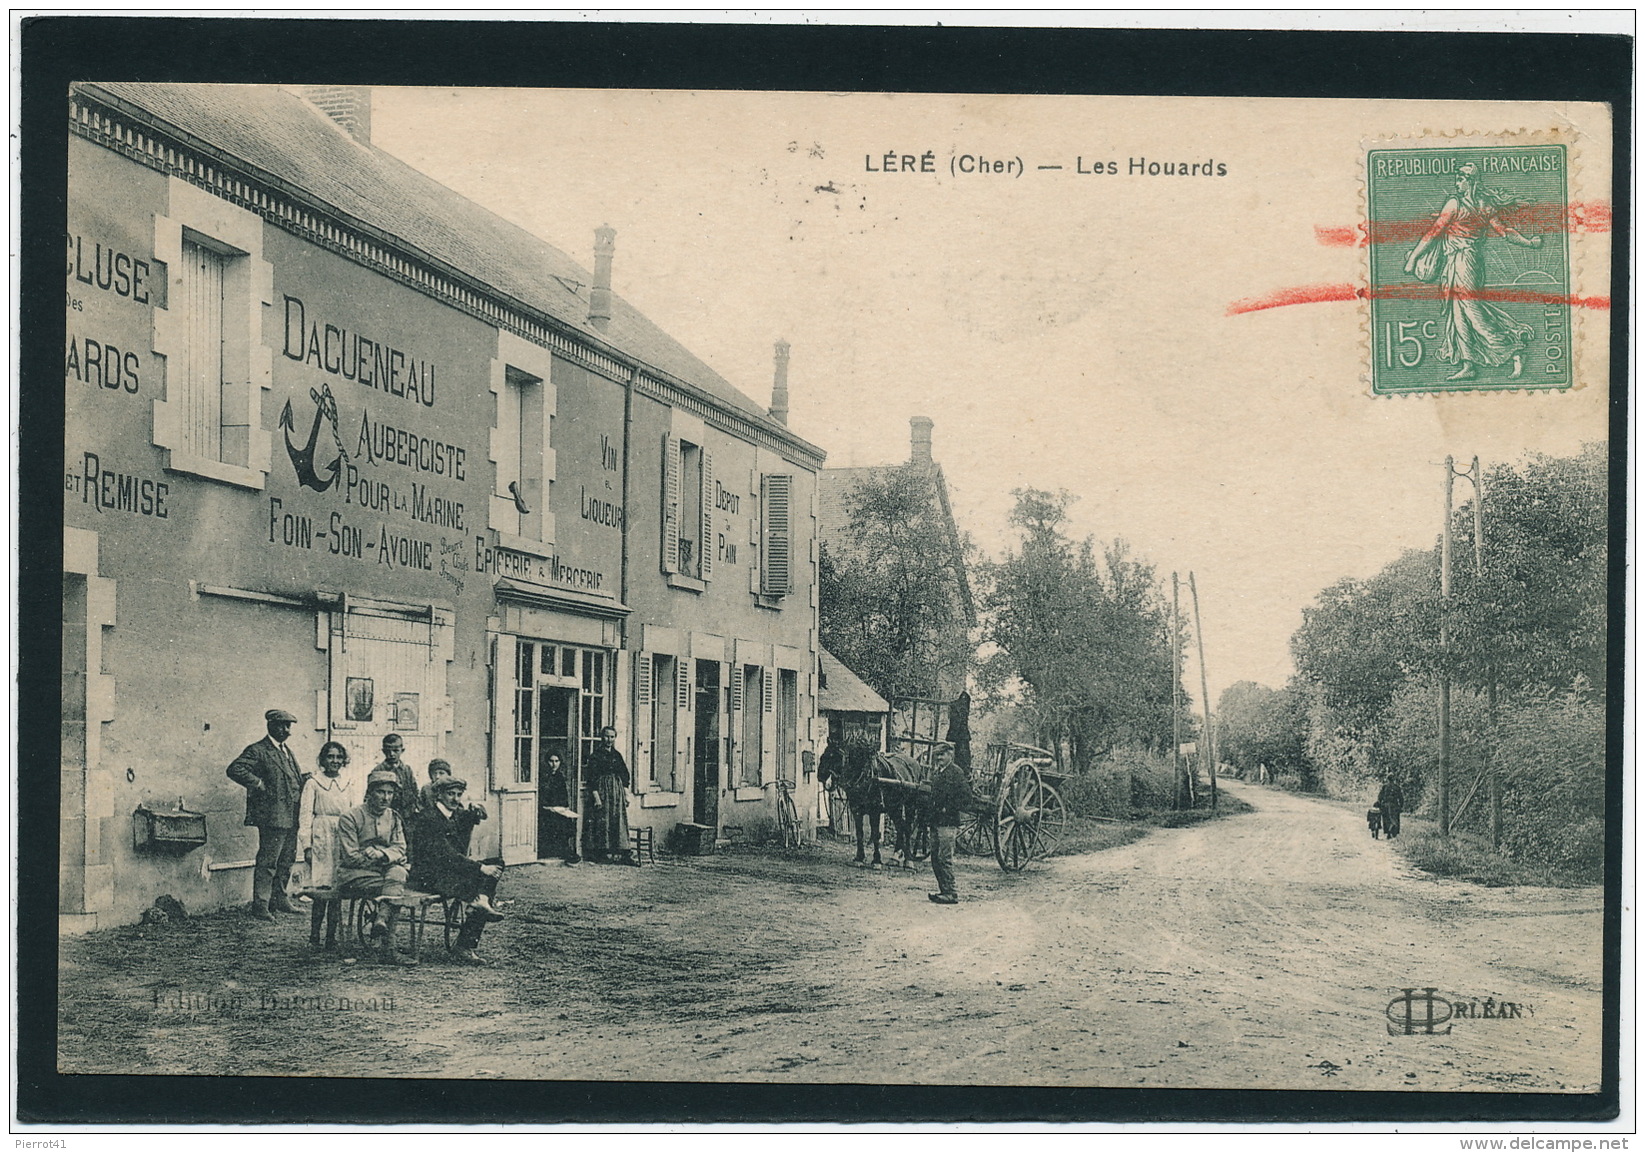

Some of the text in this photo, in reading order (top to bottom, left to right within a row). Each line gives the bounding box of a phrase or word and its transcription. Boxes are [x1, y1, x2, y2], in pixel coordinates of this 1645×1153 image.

[1482, 155, 1560, 174] FRANÇAISE
[1544, 296, 1562, 374] POSTES
[600, 434, 617, 471] VIN
[83, 451, 169, 519] REMISE
[346, 464, 390, 515] POUR
[394, 491, 407, 512] LA
